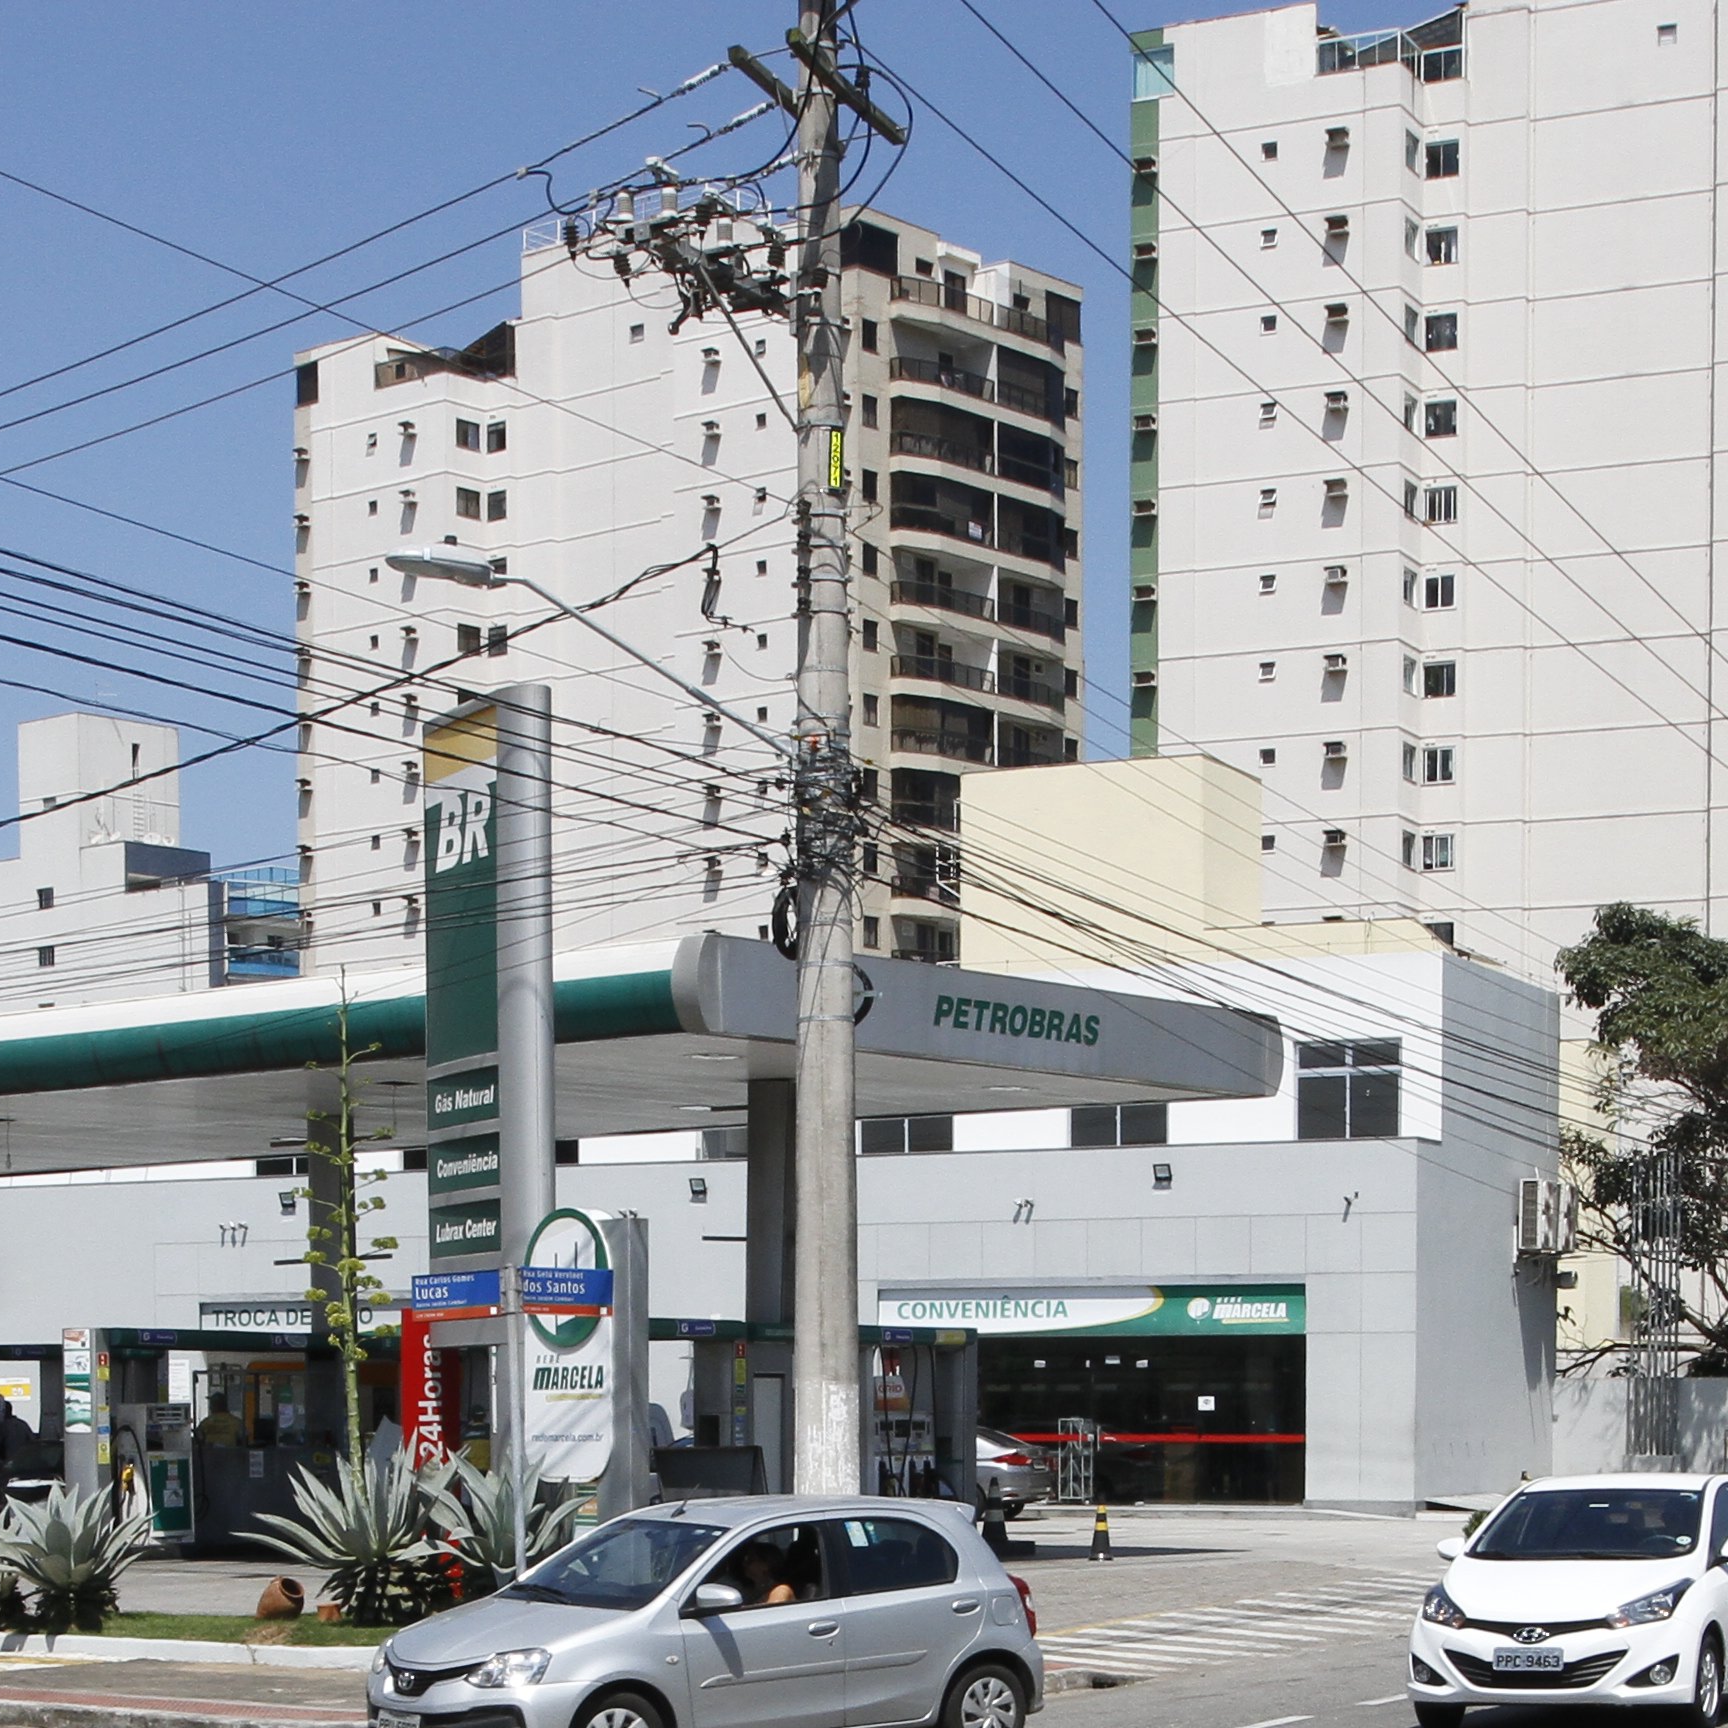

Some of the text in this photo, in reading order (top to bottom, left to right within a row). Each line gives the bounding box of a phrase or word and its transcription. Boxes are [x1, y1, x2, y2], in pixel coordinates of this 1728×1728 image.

[831, 432, 840, 486] 12071
[435, 783, 491, 873] BR
[933, 995, 1101, 1046] PETROBRAS
[454, 1084, 495, 1110] Natural
[437, 1151, 498, 1178] Conveniência
[436, 1218, 497, 1243] Lubrax Center
[415, 1275, 475, 1286] Rua Carlos Gomes
[415, 1285, 449, 1300] Lucas
[522, 1279, 585, 1294] dos Santos
[212, 1308, 312, 1327] TROCA DE
[896, 1295, 1069, 1319] CONVENIÊNCIA
[1212, 1302, 1287, 1319] MARCELA
[533, 1365, 604, 1390] MARCELA
